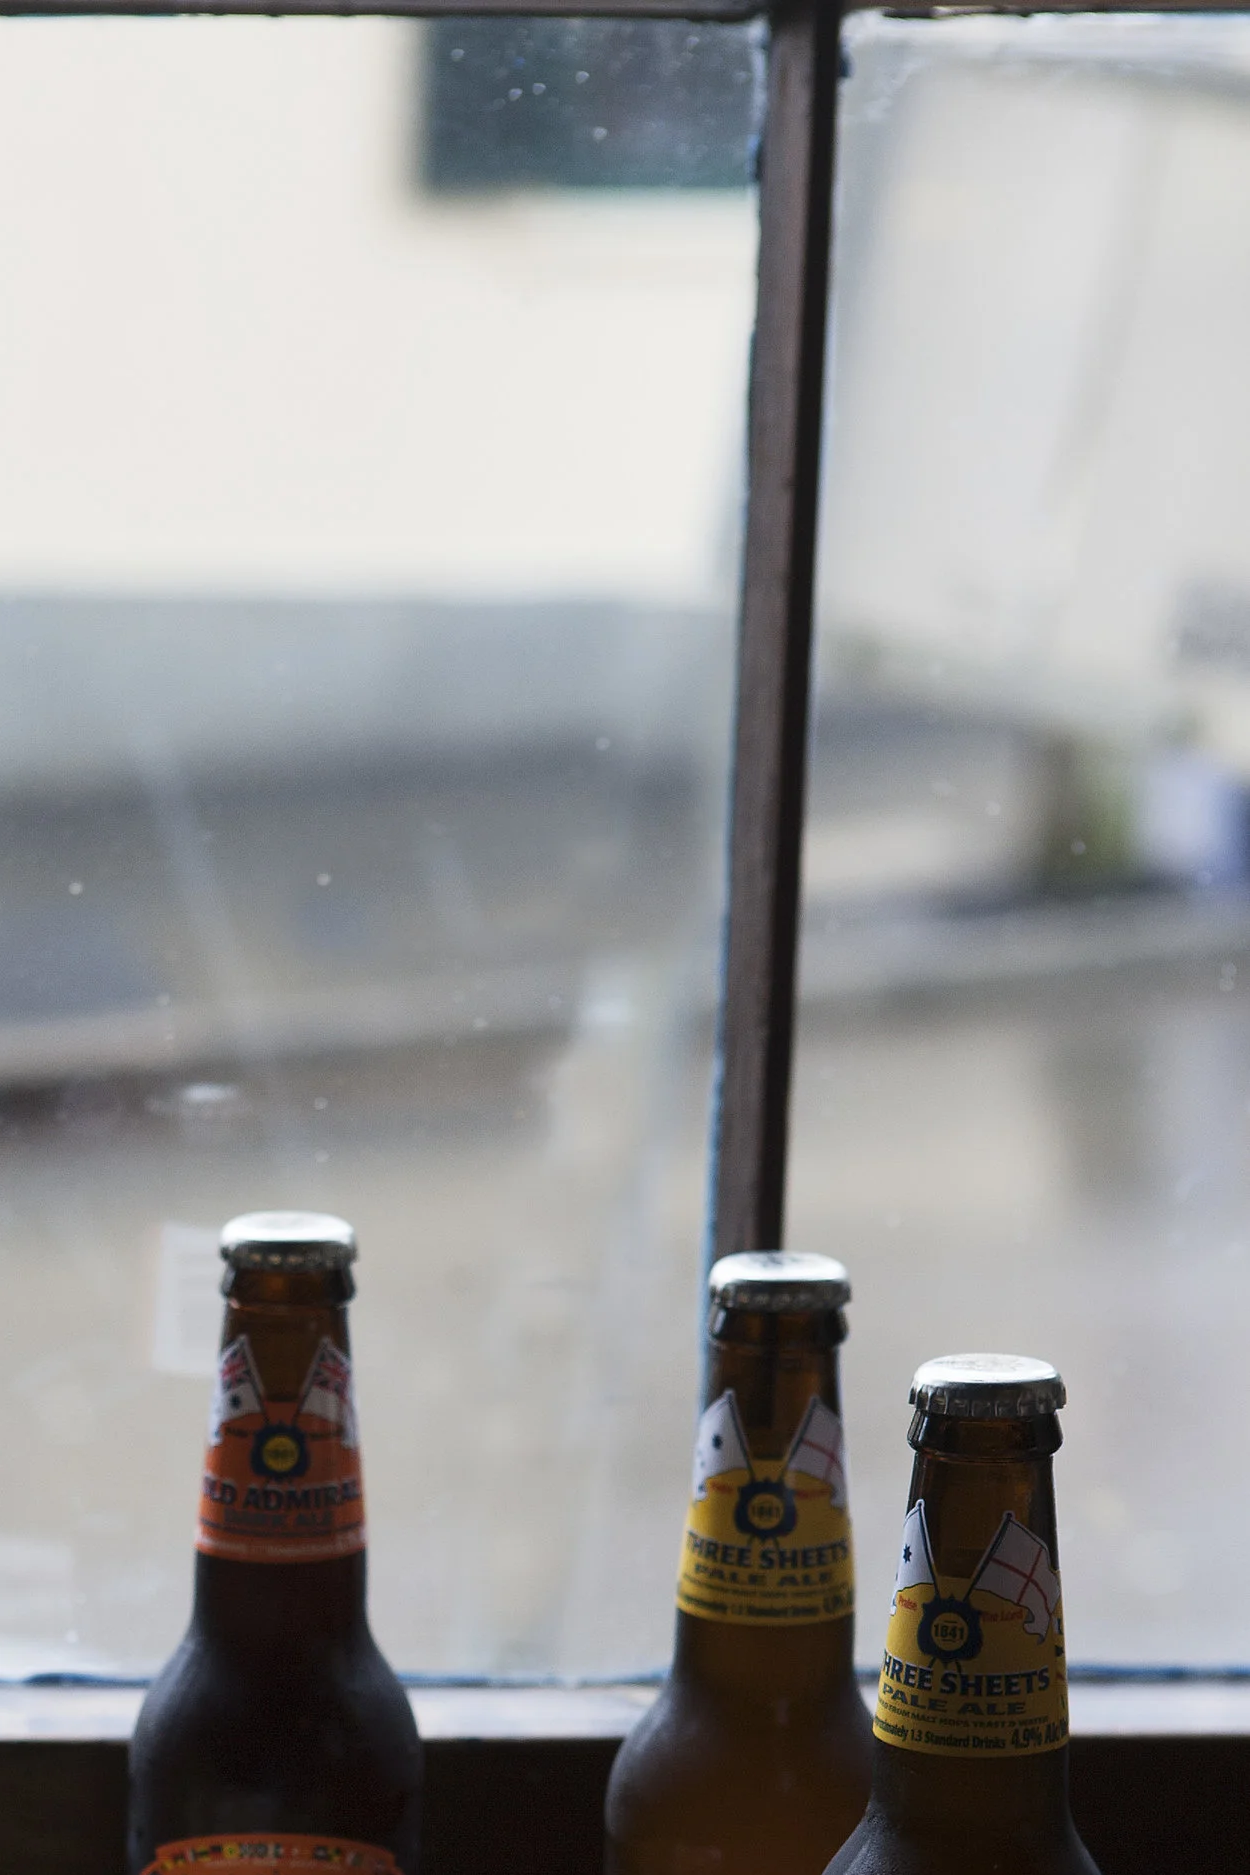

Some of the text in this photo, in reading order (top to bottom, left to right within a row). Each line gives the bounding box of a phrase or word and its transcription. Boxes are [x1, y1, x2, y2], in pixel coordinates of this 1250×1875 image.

[934, 1624, 964, 1640] 1841
[884, 1649, 1051, 1697] HREE SHEETS
[882, 1683, 948, 1714] PALE
[958, 1702, 1027, 1717] ALE
[924, 1730, 970, 1749] Standard
[973, 1735, 1006, 1750] Drinks
